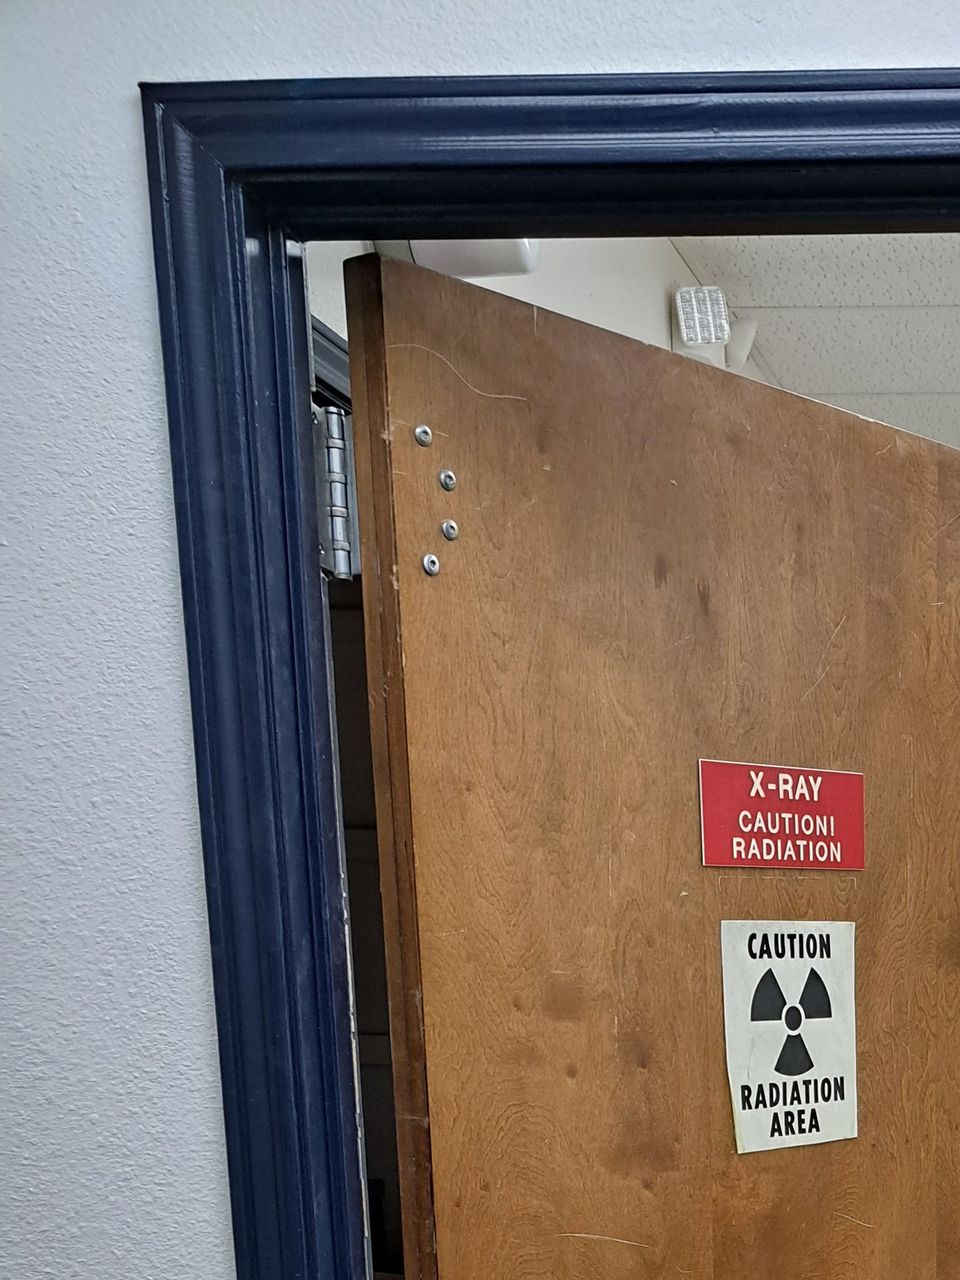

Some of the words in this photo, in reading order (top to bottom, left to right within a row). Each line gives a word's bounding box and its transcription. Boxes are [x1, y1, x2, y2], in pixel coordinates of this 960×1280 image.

[749, 770, 822, 801] X-RAY
[732, 837, 841, 862] RADIATION
[747, 932, 831, 959] CAUTION
[740, 1076, 845, 1110] RADIATION
[769, 1108, 820, 1137] AREA
